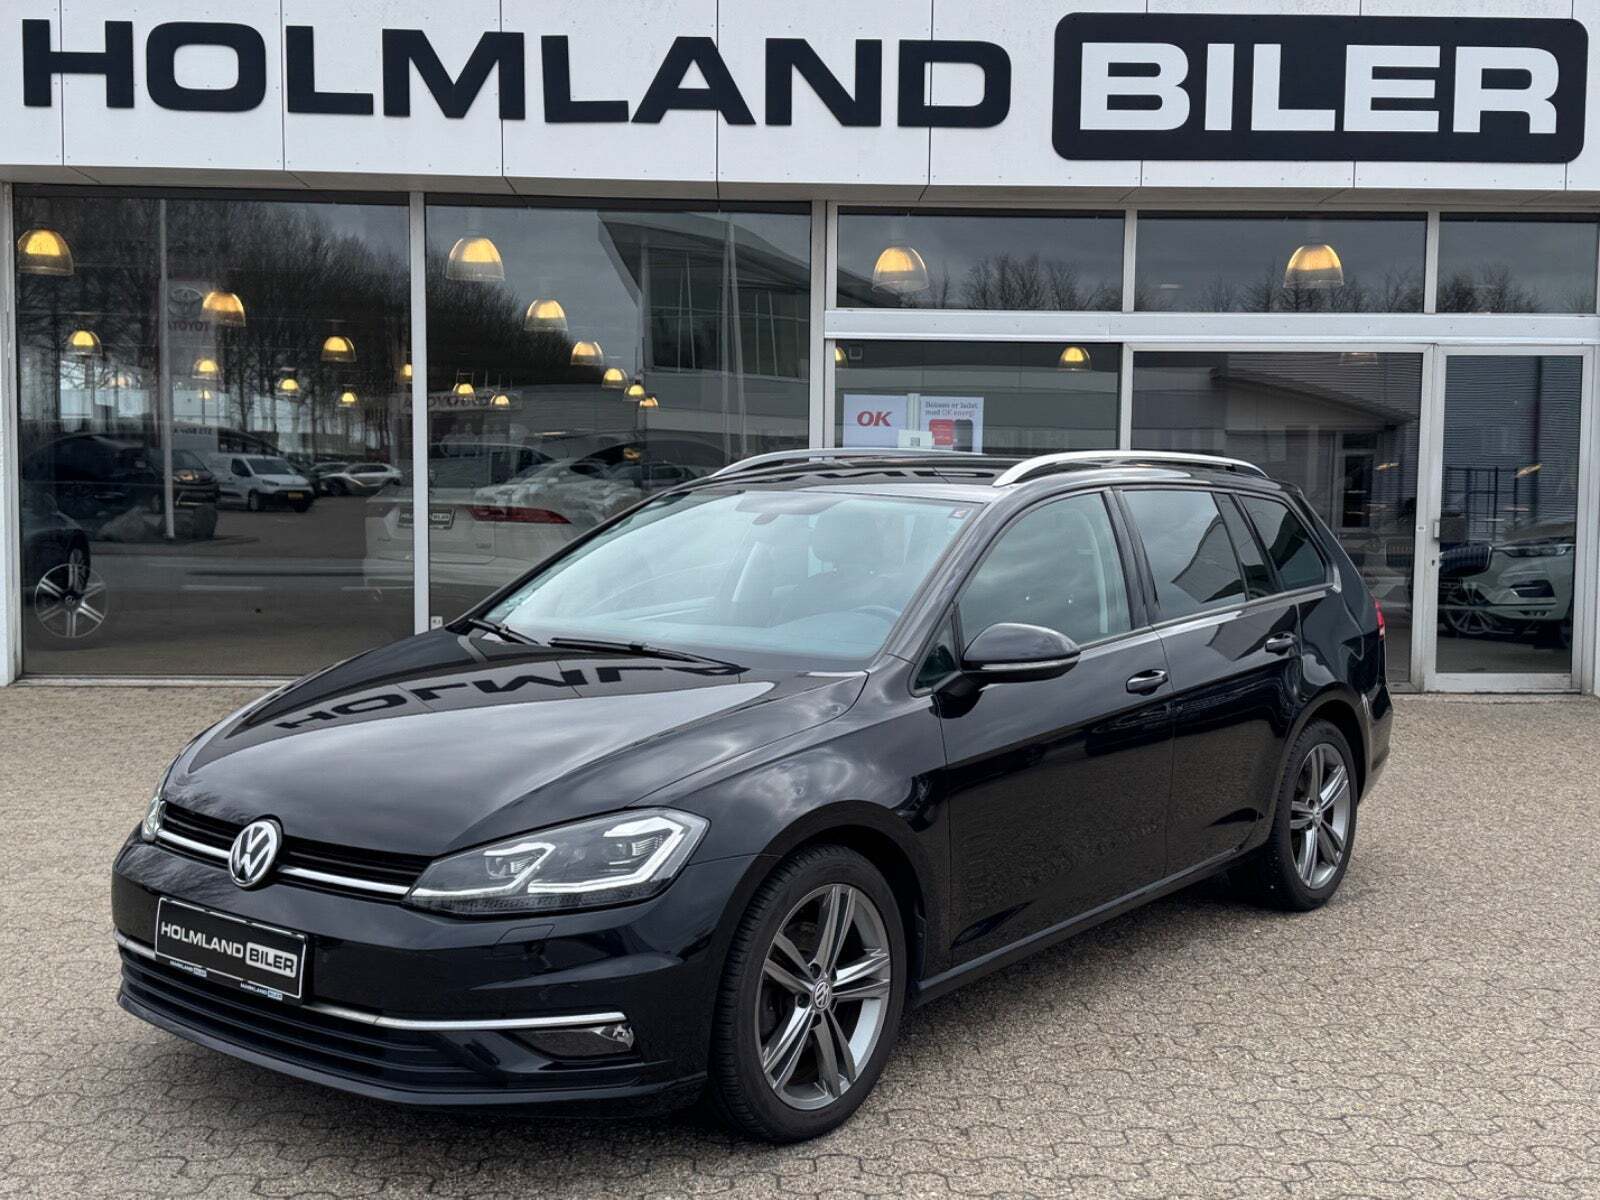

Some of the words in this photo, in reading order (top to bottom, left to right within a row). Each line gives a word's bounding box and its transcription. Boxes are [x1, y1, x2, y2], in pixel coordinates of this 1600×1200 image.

[22, 18, 1011, 129] HOLMLAND
[1079, 42, 1560, 135] BILER
[856, 410, 892, 427] OK
[160, 921, 244, 959] HOLMLAND
[249, 947, 295, 974] BILER
